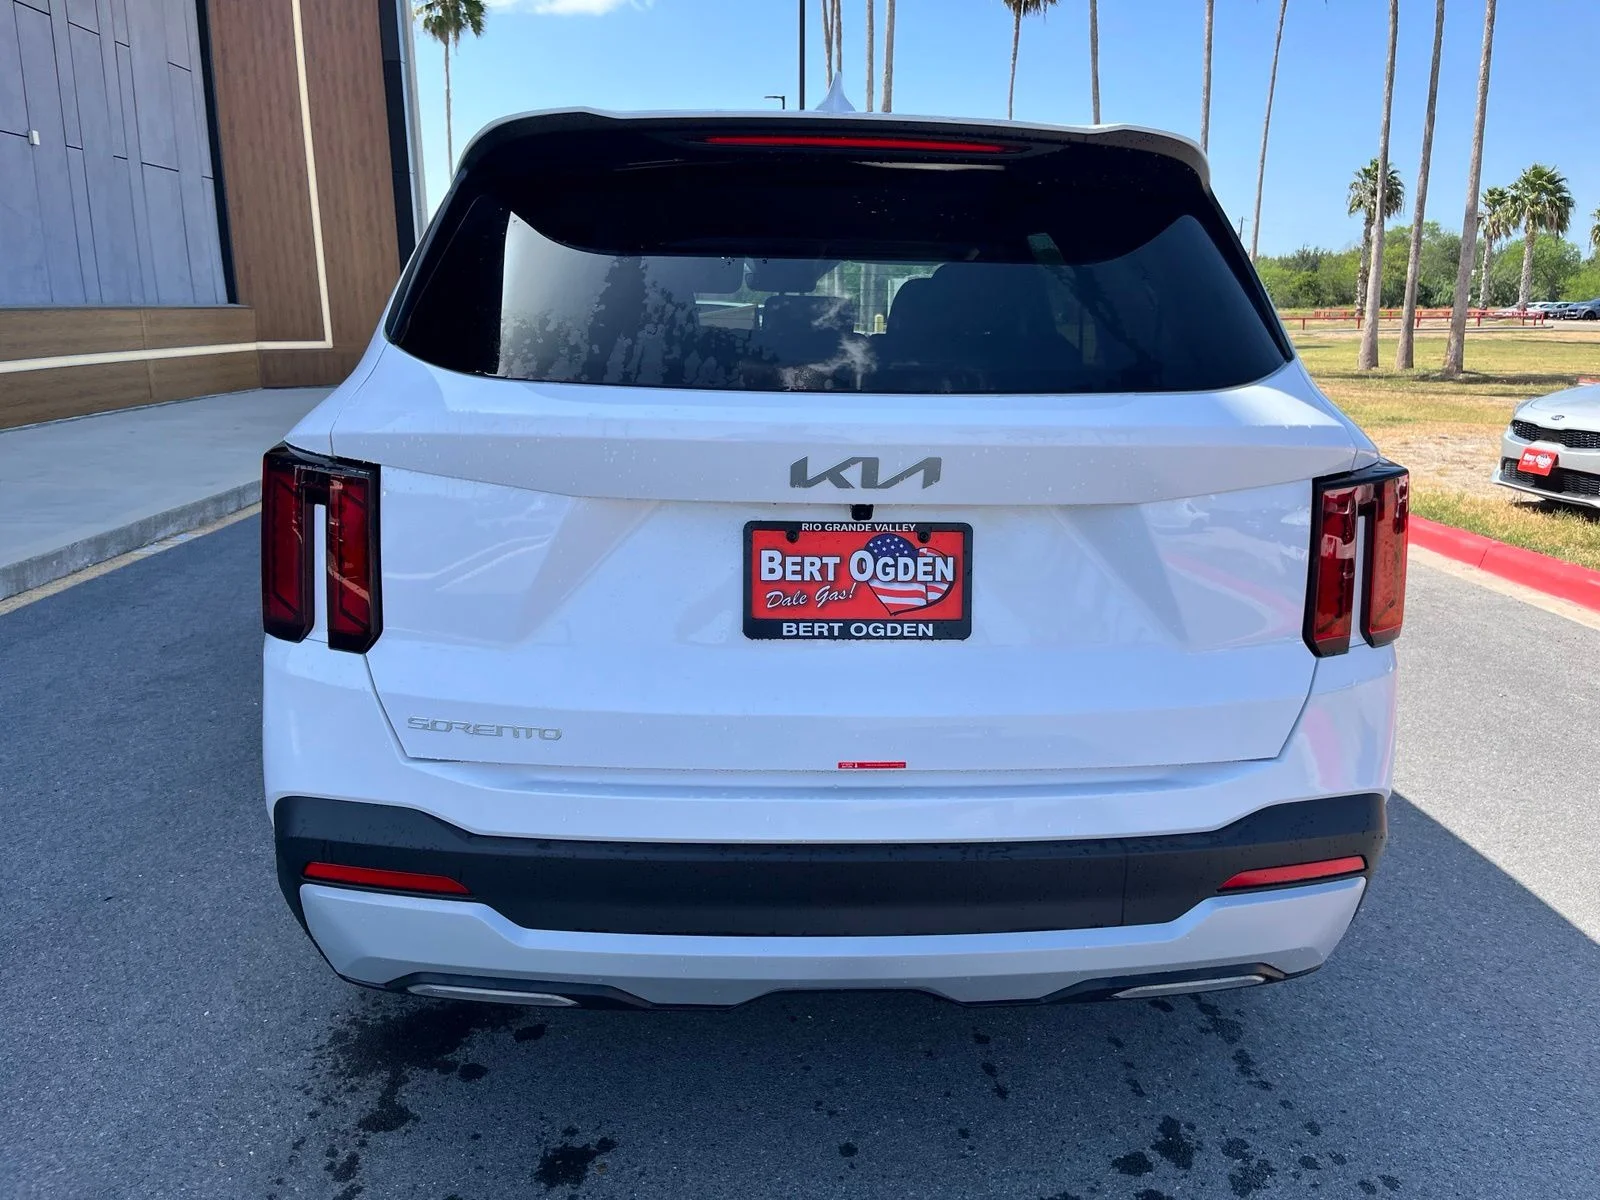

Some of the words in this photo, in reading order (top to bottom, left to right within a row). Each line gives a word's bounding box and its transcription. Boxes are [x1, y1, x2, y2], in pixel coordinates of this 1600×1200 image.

[790, 456, 942, 489] KIA
[802, 523, 822, 532] RIO
[825, 523, 872, 532] GRANDE
[874, 523, 916, 532] VALLEY
[760, 550, 841, 582] BERT
[850, 550, 954, 582] OGDEN
[766, 590, 807, 609] Dale
[815, 583, 857, 608] Gas!
[782, 622, 843, 636] BERT
[850, 623, 934, 637] OGDEN
[407, 716, 563, 741] SORENTO
